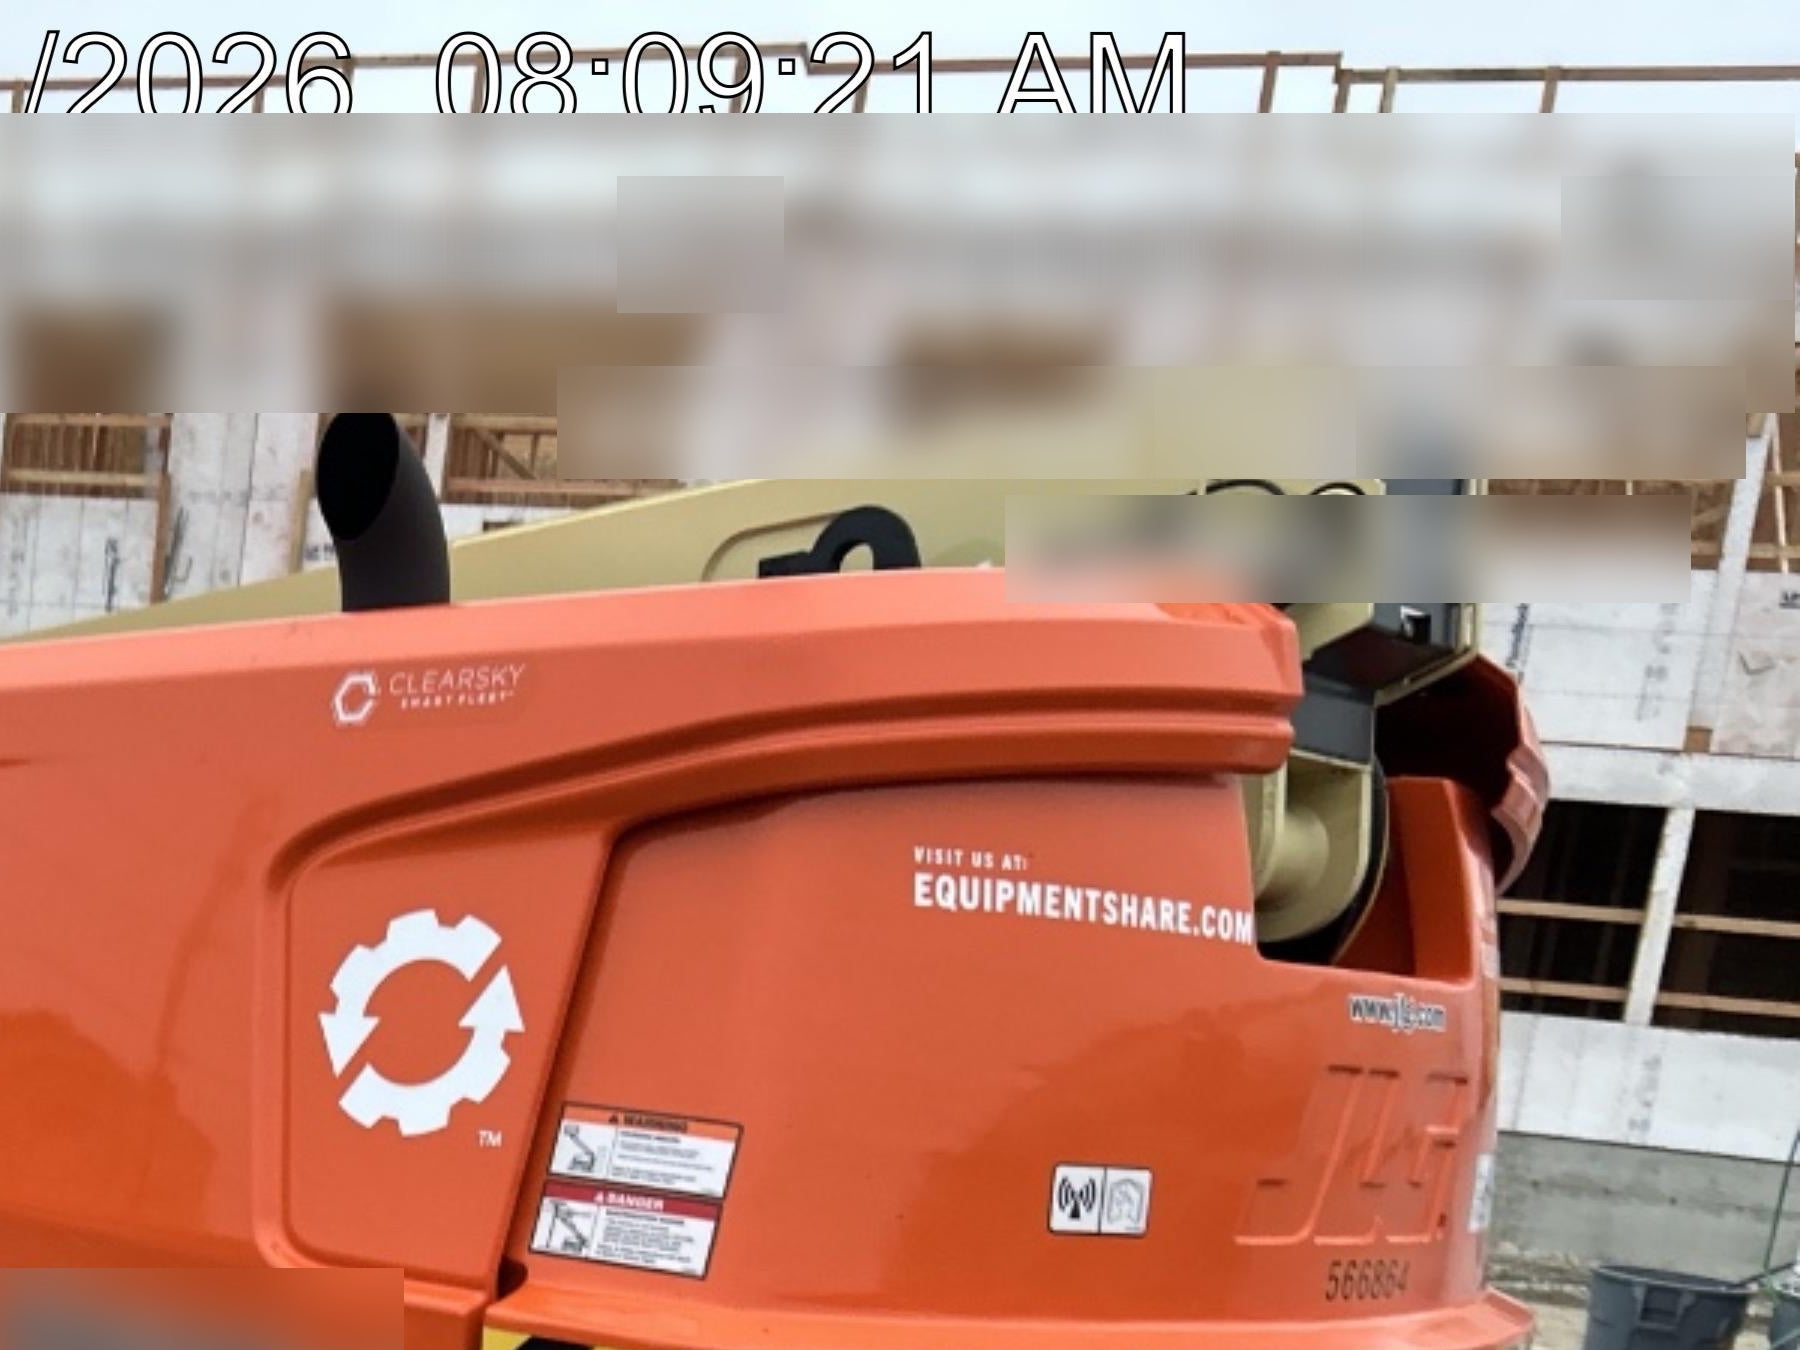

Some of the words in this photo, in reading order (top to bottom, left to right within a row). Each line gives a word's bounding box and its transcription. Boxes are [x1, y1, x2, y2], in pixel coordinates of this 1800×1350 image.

[389, 663, 526, 696] CLEARSKY
[913, 846, 963, 867] VISIT
[971, 851, 994, 869] US
[1001, 853, 1028, 871] AT:
[913, 871, 1253, 945] EQUIPMENTSHARE.COM
[1325, 1258, 1411, 1302] 566864
